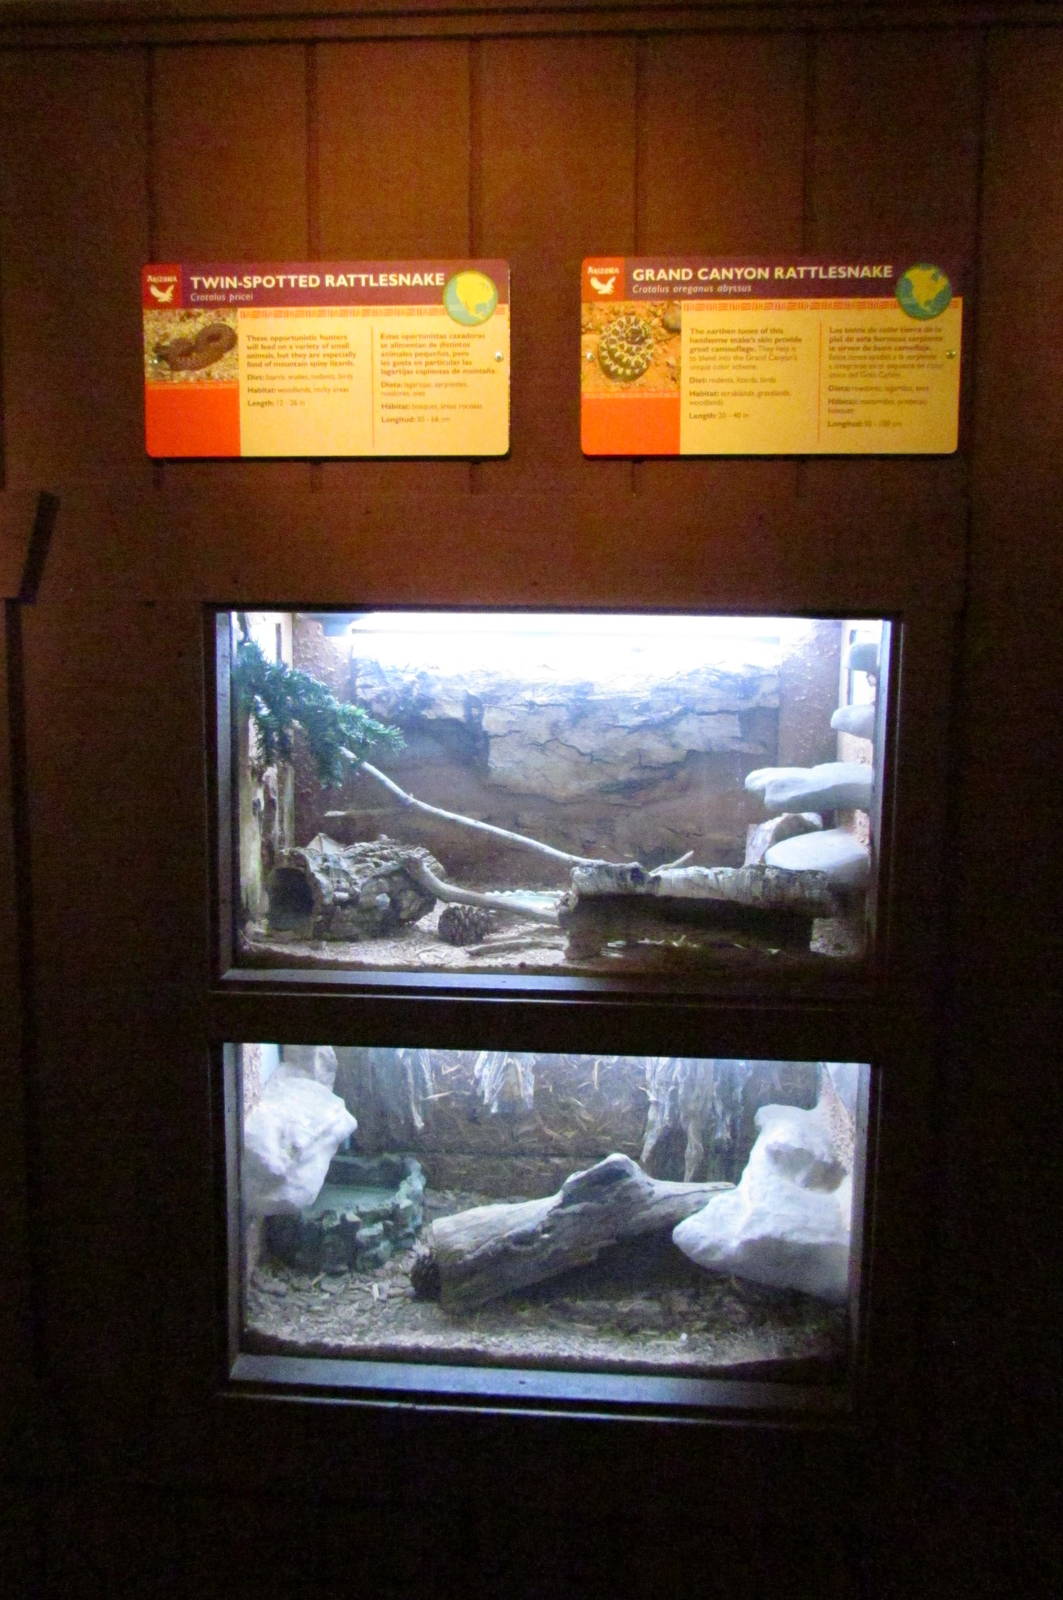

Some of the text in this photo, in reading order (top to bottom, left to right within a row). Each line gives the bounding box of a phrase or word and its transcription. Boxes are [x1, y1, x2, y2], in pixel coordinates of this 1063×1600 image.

[190, 273, 444, 289] TWIN-SPOTTED RATTLESNAKE
[633, 266, 893, 282] GRAND CANYON RATTLESNAKE
[633, 283, 751, 296] Crotalus oreganus abyssus
[229, 293, 253, 303] pricei
